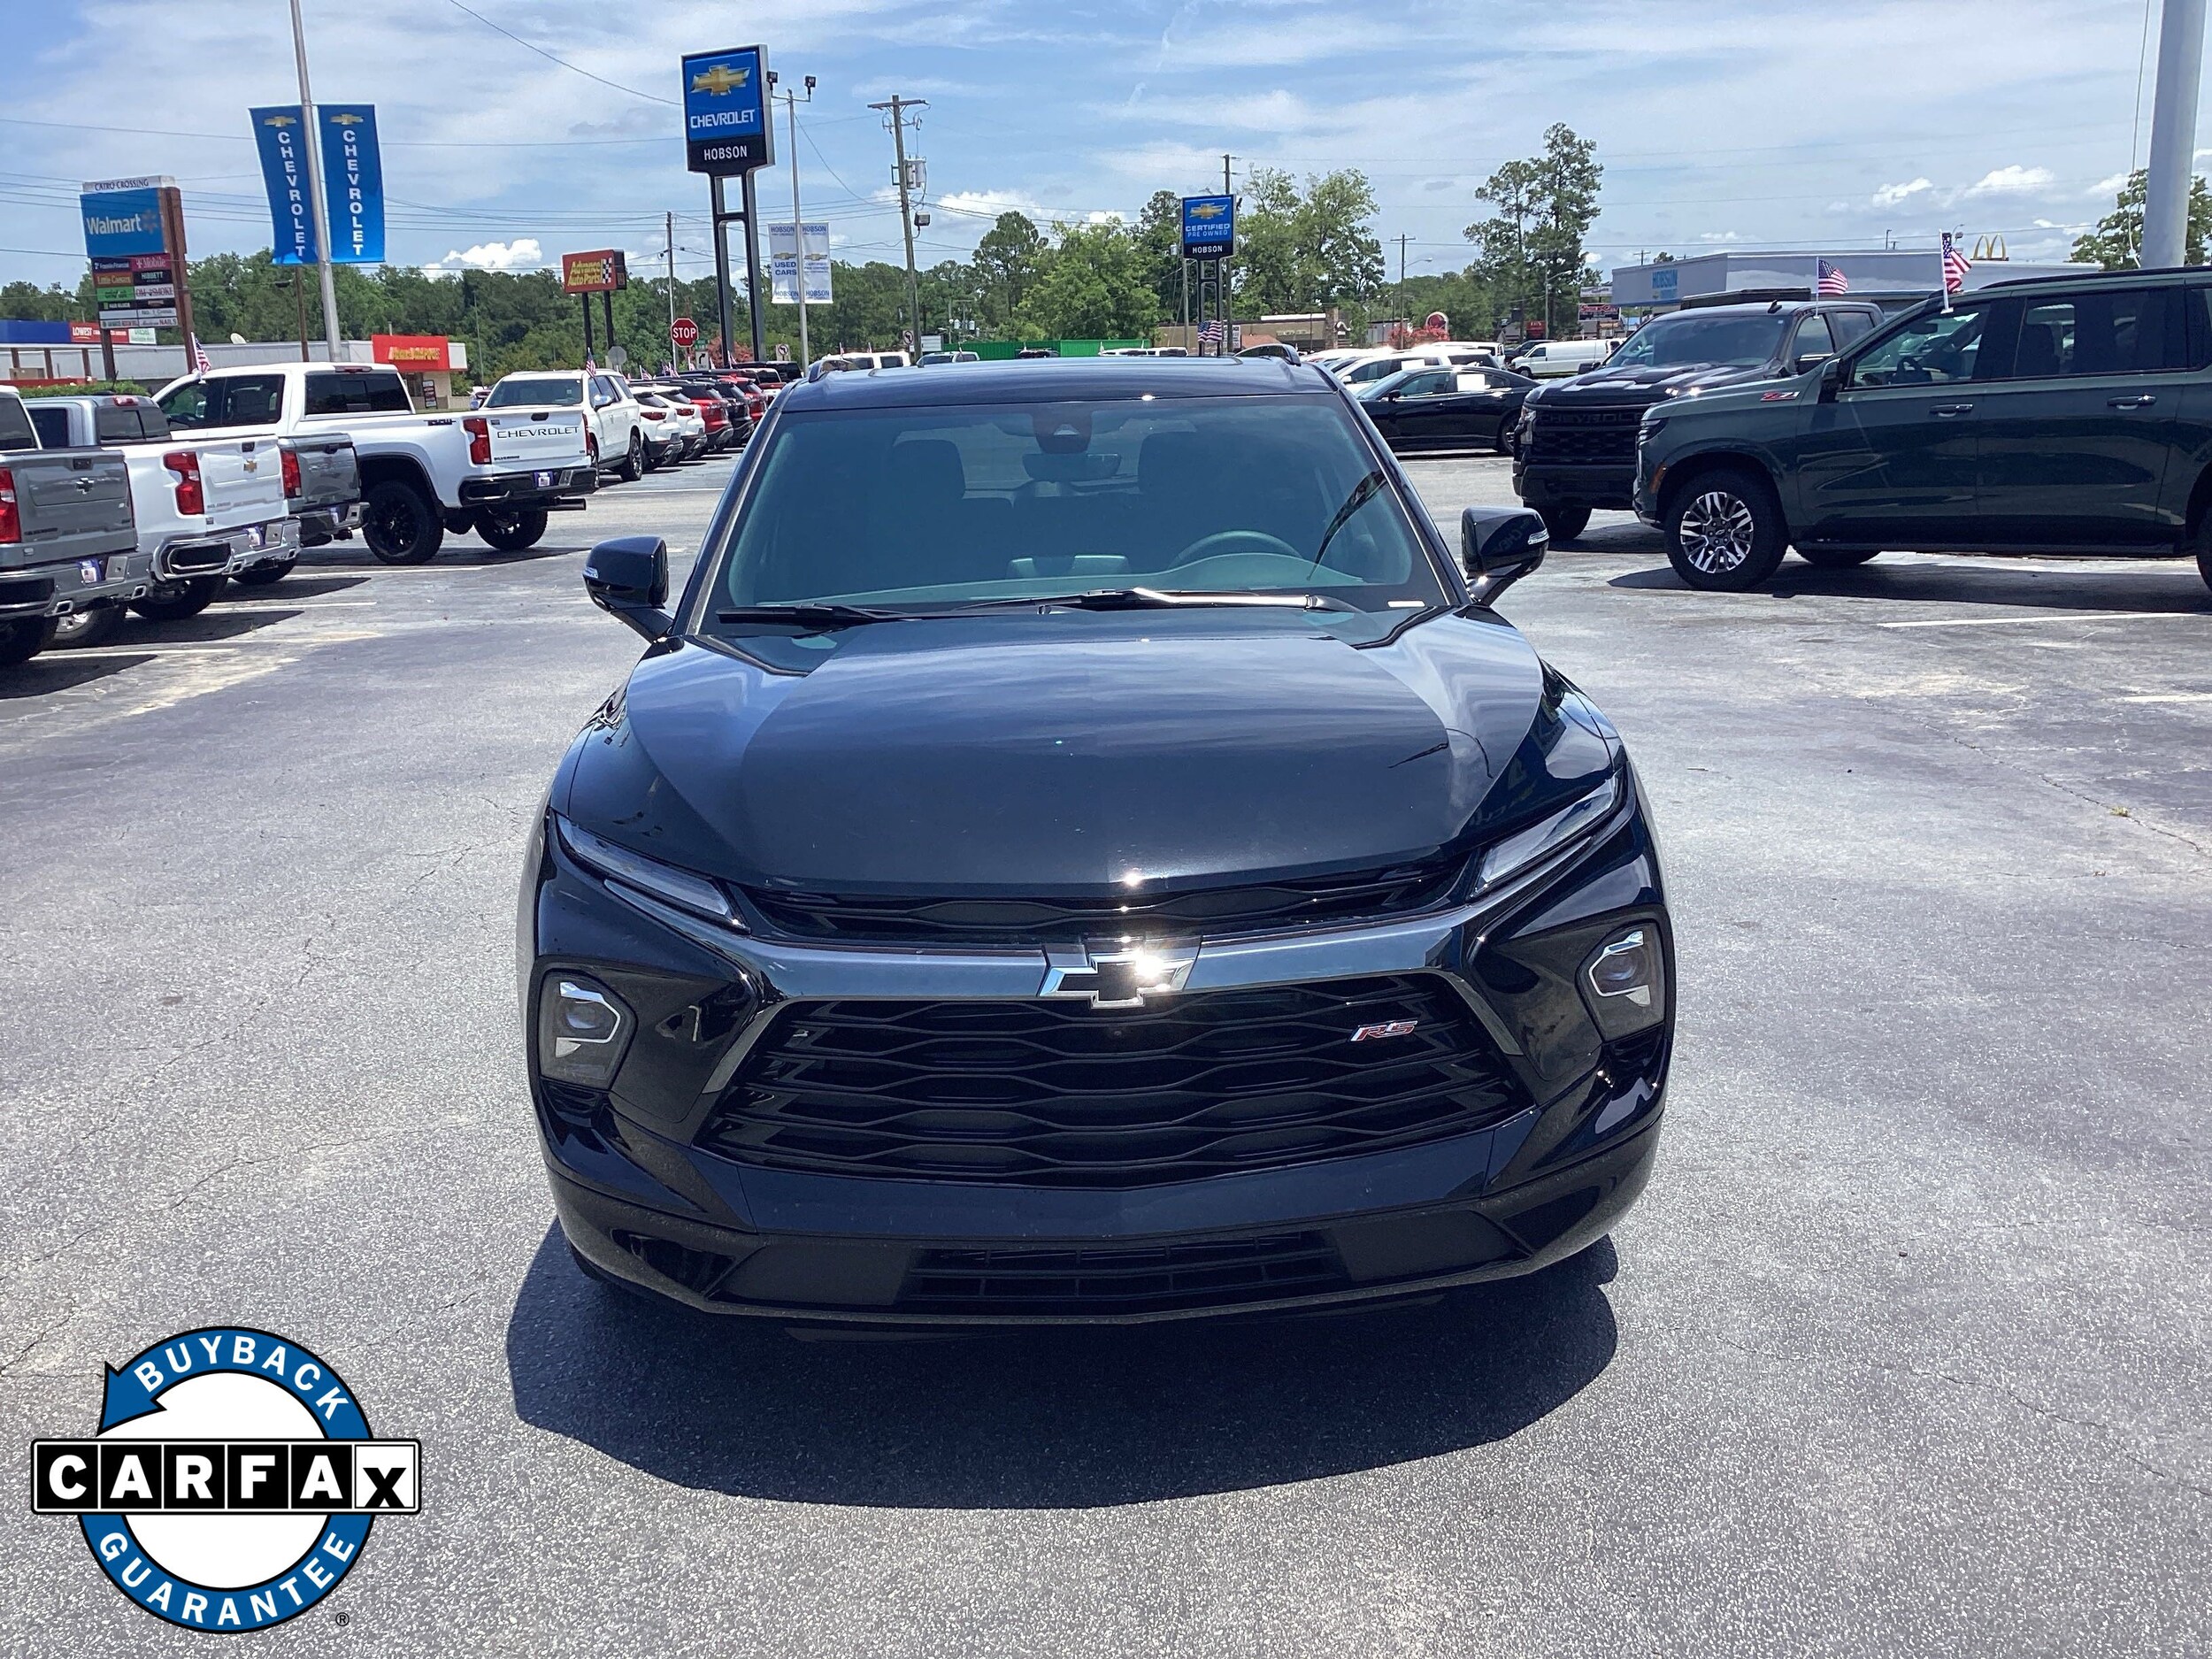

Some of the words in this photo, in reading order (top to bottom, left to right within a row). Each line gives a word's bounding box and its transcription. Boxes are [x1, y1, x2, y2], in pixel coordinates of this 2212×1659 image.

[690, 109, 756, 129] CHEVROLET
[703, 145, 748, 160] HOBSON
[116, 178, 150, 188] CROSSING
[277, 132, 306, 257] CHEVROLET
[342, 130, 364, 256] CHEVROLET
[87, 213, 142, 235] Walmart
[1186, 223, 1231, 232] CERTIFIED
[1192, 245, 1223, 254] HOBSON
[570, 260, 602, 274] Advance
[567, 274, 584, 286] Auto
[72, 327, 93, 336] LOWEST
[672, 327, 696, 339] STOP
[1540, 412, 1643, 424] CHEVROLE
[497, 426, 580, 439] CHEVROLET
[1350, 1020, 1418, 1042] RS
